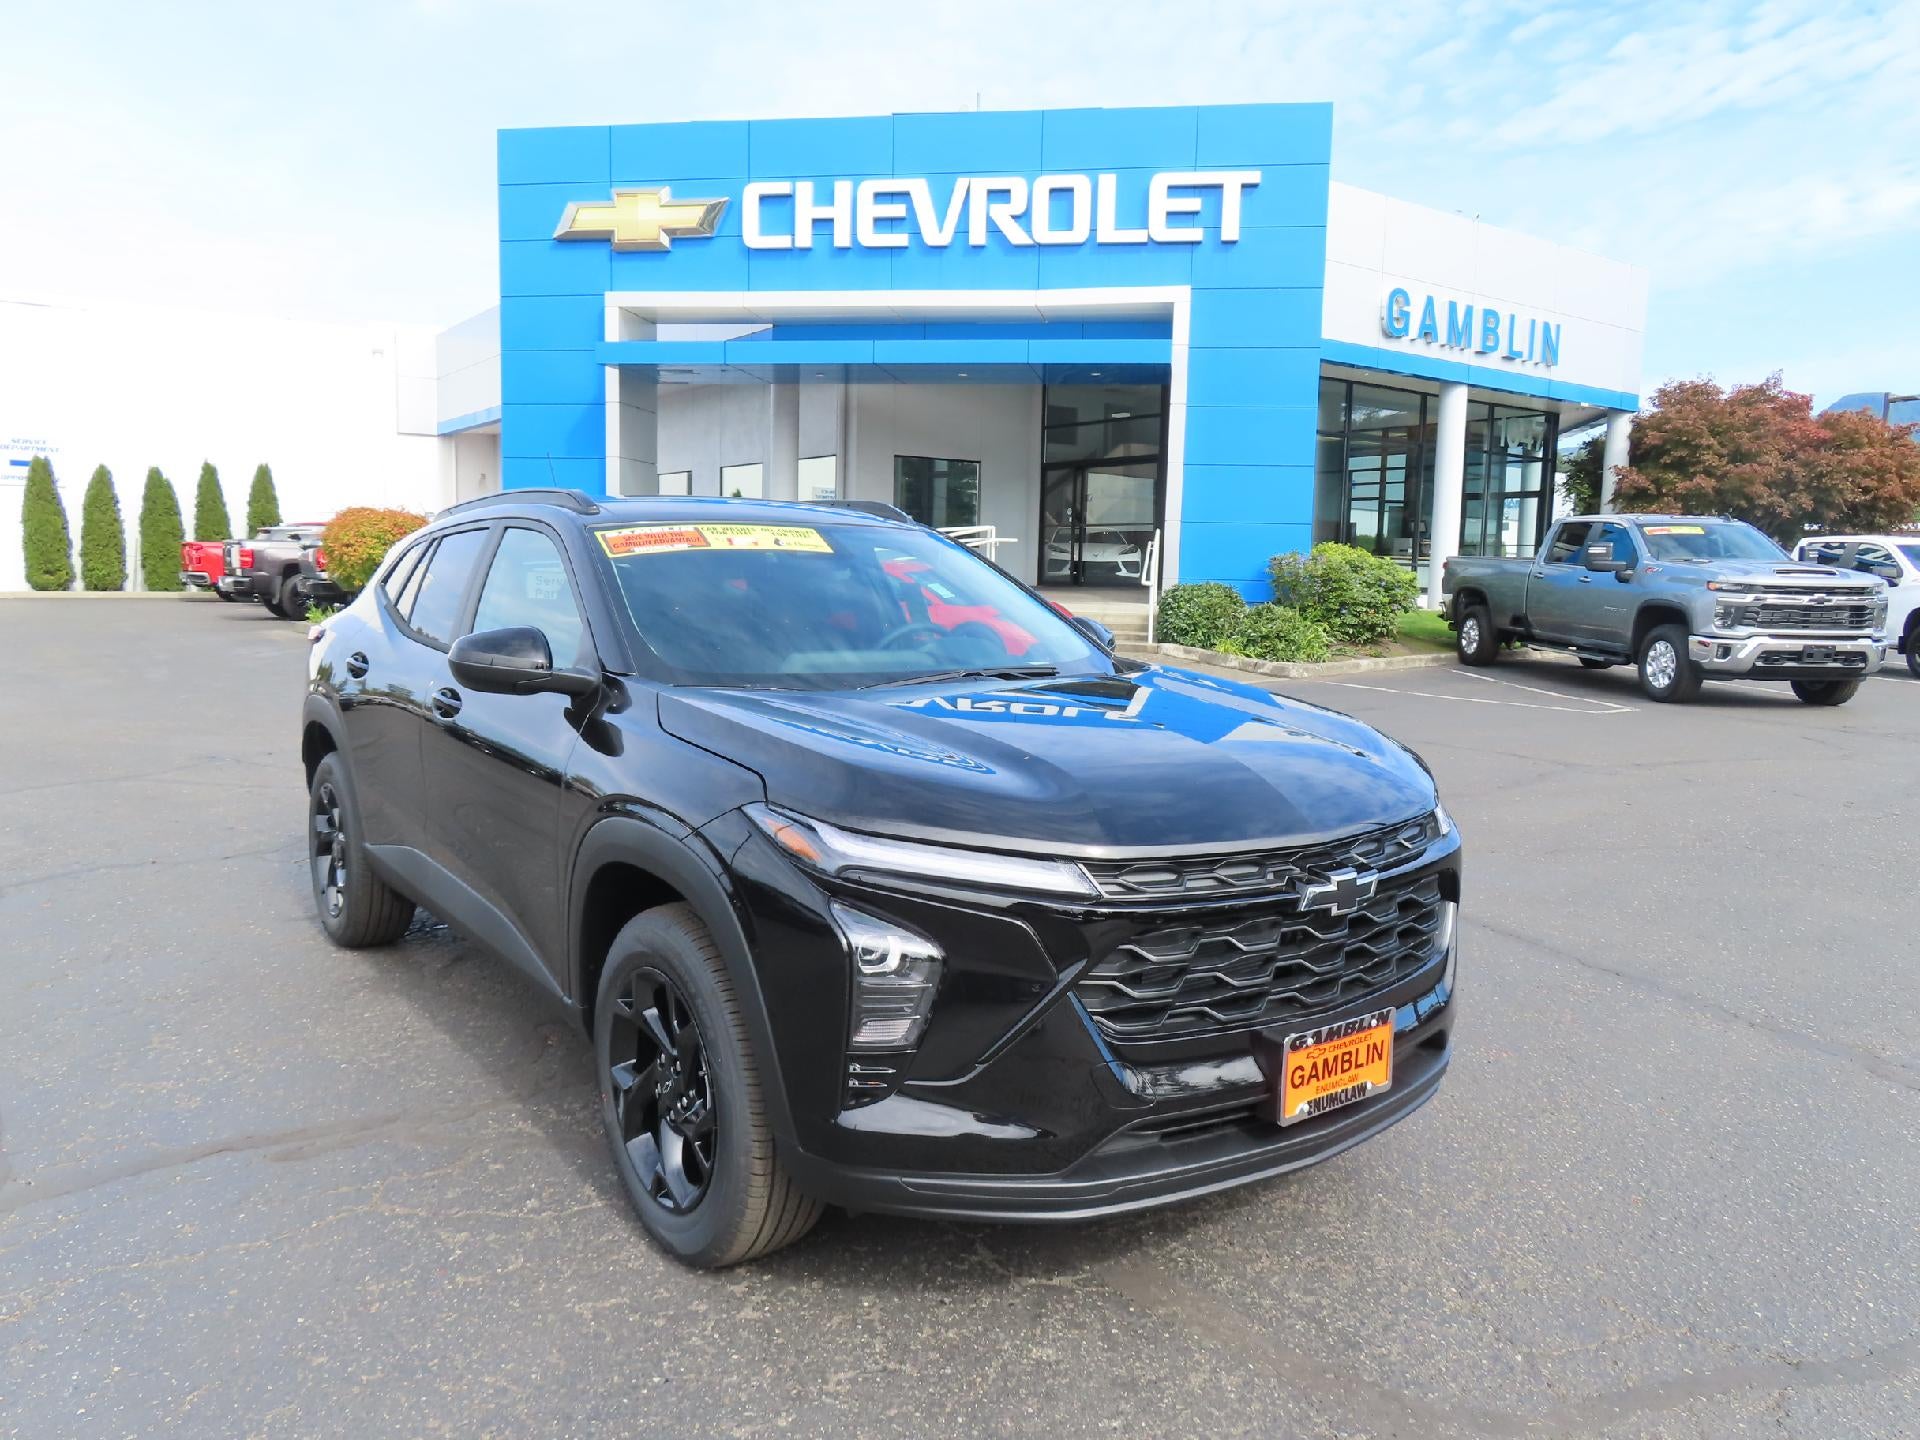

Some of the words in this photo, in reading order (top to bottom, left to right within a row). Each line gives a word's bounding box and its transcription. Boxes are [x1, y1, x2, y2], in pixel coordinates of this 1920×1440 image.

[742, 171, 1261, 249] CHEVROLET
[1383, 287, 1561, 367] GAMBLIN
[1289, 1010, 1392, 1051] GAMBLIN
[1328, 1032, 1374, 1054] CHEVROLET
[1290, 1040, 1385, 1090] GAMBLIN
[1315, 1073, 1360, 1095] ENUMCLAW
[1306, 1081, 1368, 1117] ENUMCLAW
